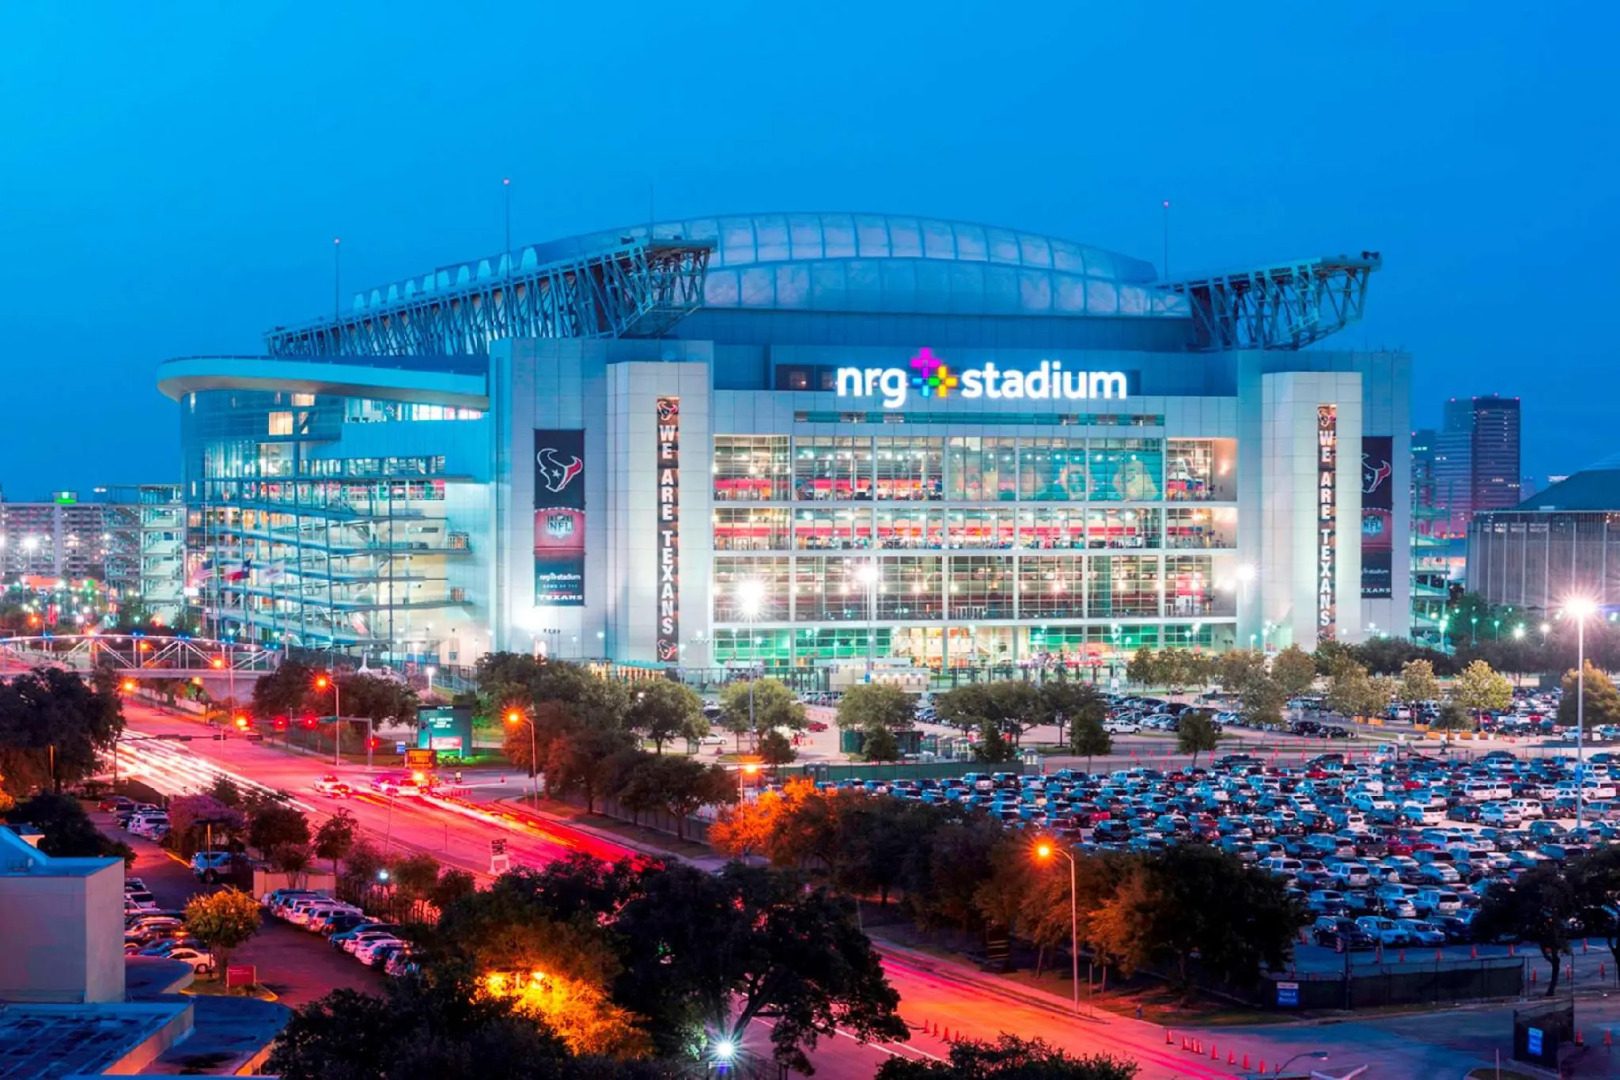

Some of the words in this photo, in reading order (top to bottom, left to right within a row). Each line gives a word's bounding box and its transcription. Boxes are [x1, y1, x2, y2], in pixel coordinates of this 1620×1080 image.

[837, 366, 907, 408] nrg
[961, 360, 1127, 399] stadium
[659, 424, 677, 459] WE
[1319, 430, 1335, 463] WE
[661, 468, 674, 521] ARE
[1320, 471, 1332, 520] ARE
[549, 522, 572, 532] NFL
[661, 530, 674, 635] TEXANS
[1320, 529, 1332, 627] TEXANS
